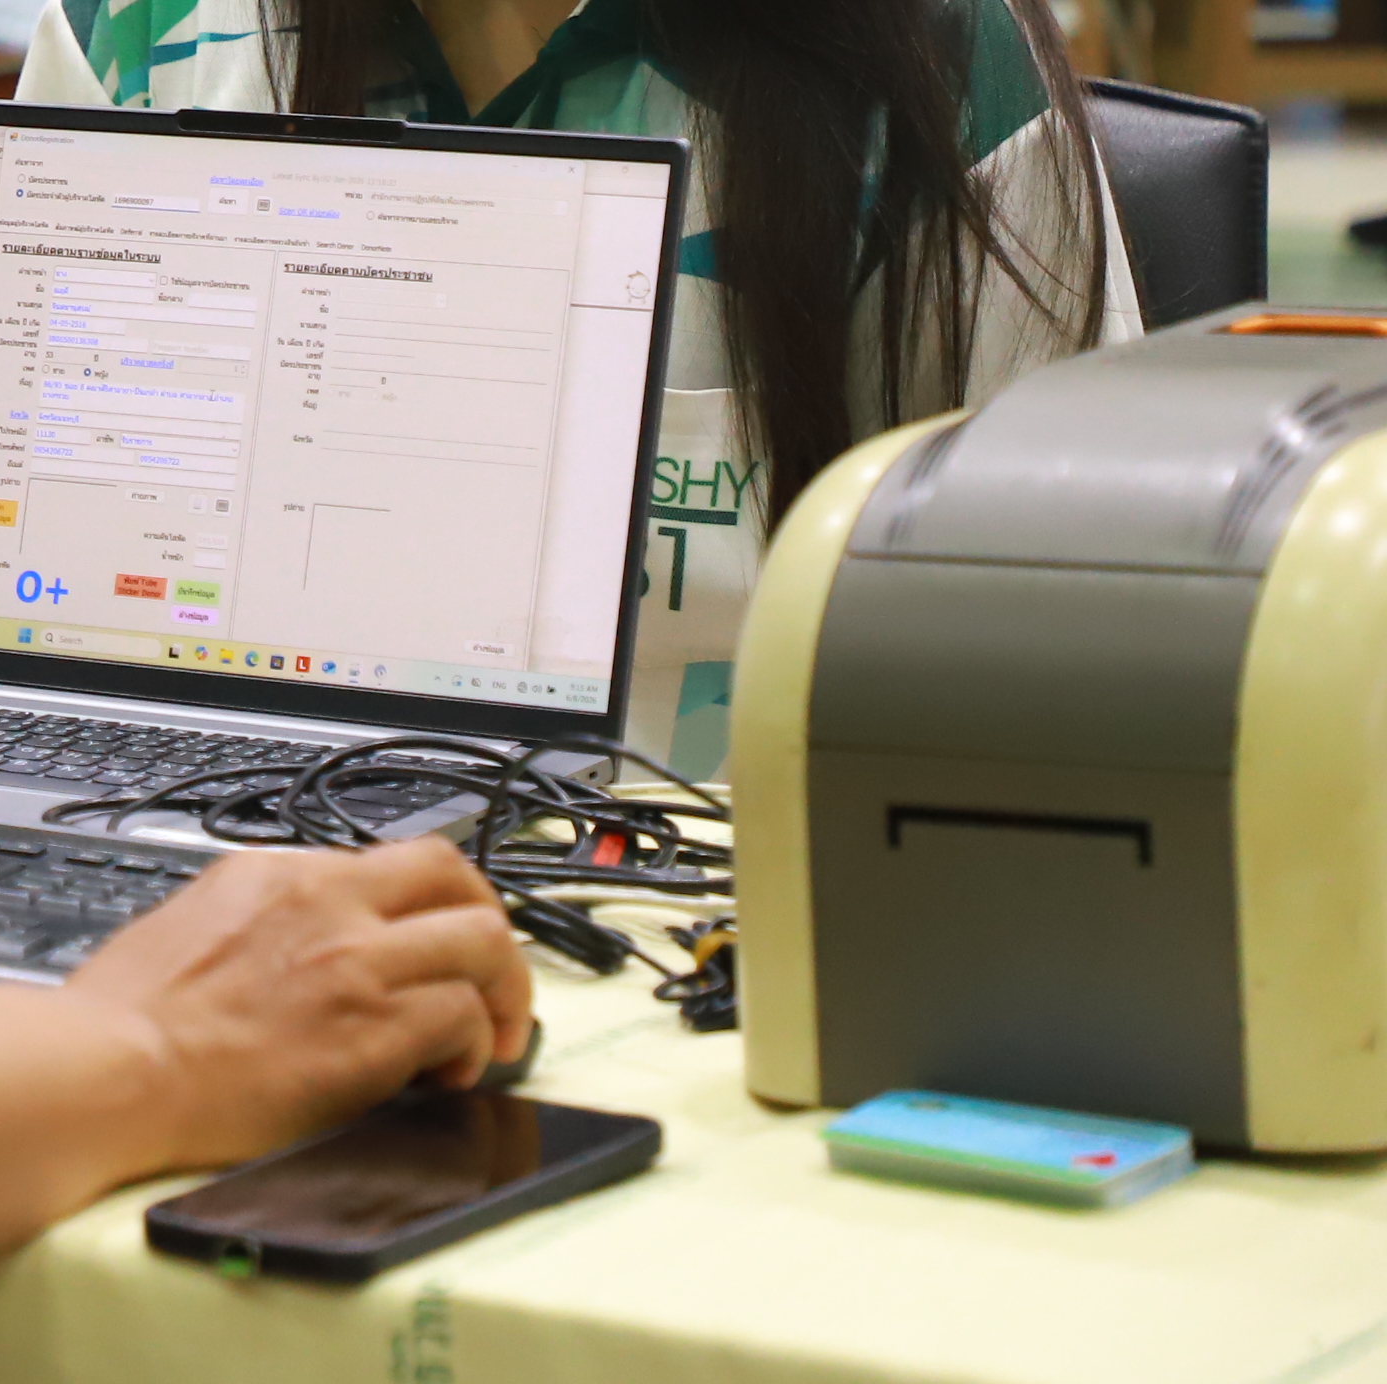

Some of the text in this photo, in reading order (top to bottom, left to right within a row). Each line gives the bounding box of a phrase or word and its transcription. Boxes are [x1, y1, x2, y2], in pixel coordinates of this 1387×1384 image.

[20, 134, 75, 144] DonorRegistration
[2, 242, 161, 264] รายละเอียดตามฐานข้อมูลในระบบ
[284, 262, 433, 283] รายละเอียดตามบัตรประชาชน
[59, 634, 84, 646] Search
[492, 681, 507, 690] ENG
